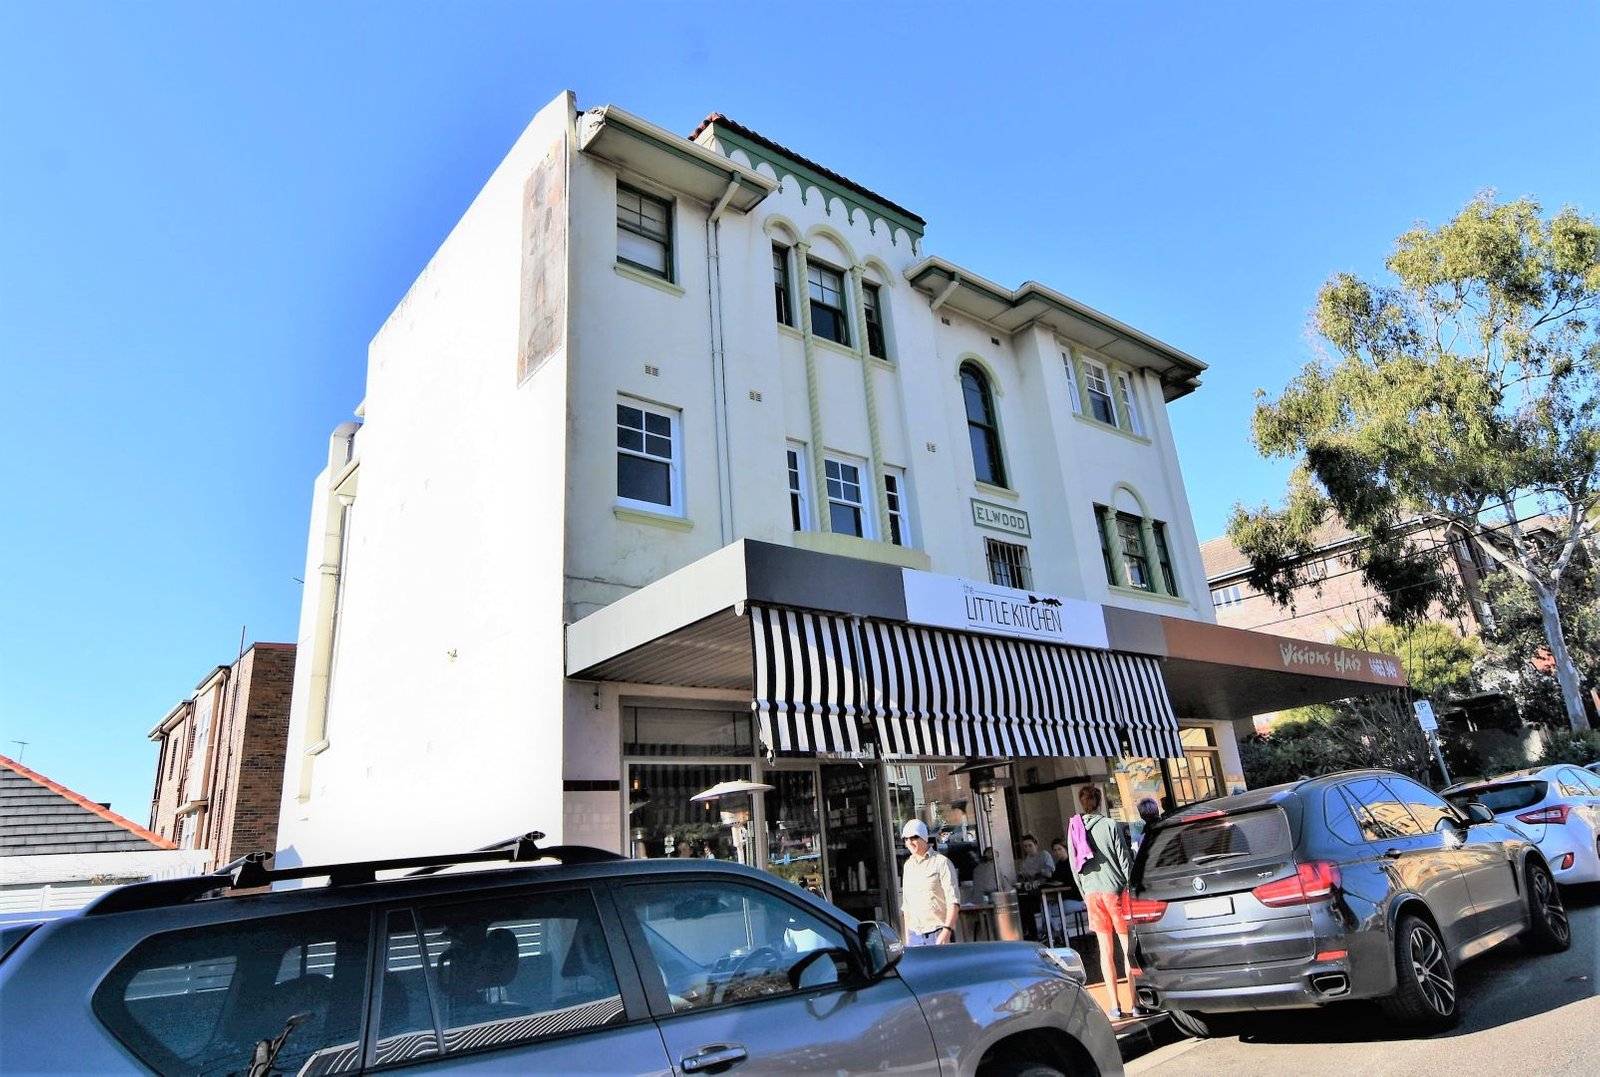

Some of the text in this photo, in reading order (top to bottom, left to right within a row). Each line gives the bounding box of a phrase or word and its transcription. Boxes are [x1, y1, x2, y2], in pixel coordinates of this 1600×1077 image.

[976, 506, 1025, 530] ELWOOD
[964, 595, 1063, 632] LITTLE KITCHEN
[1280, 643, 1331, 667] Visions
[1334, 650, 1362, 674] Hair
